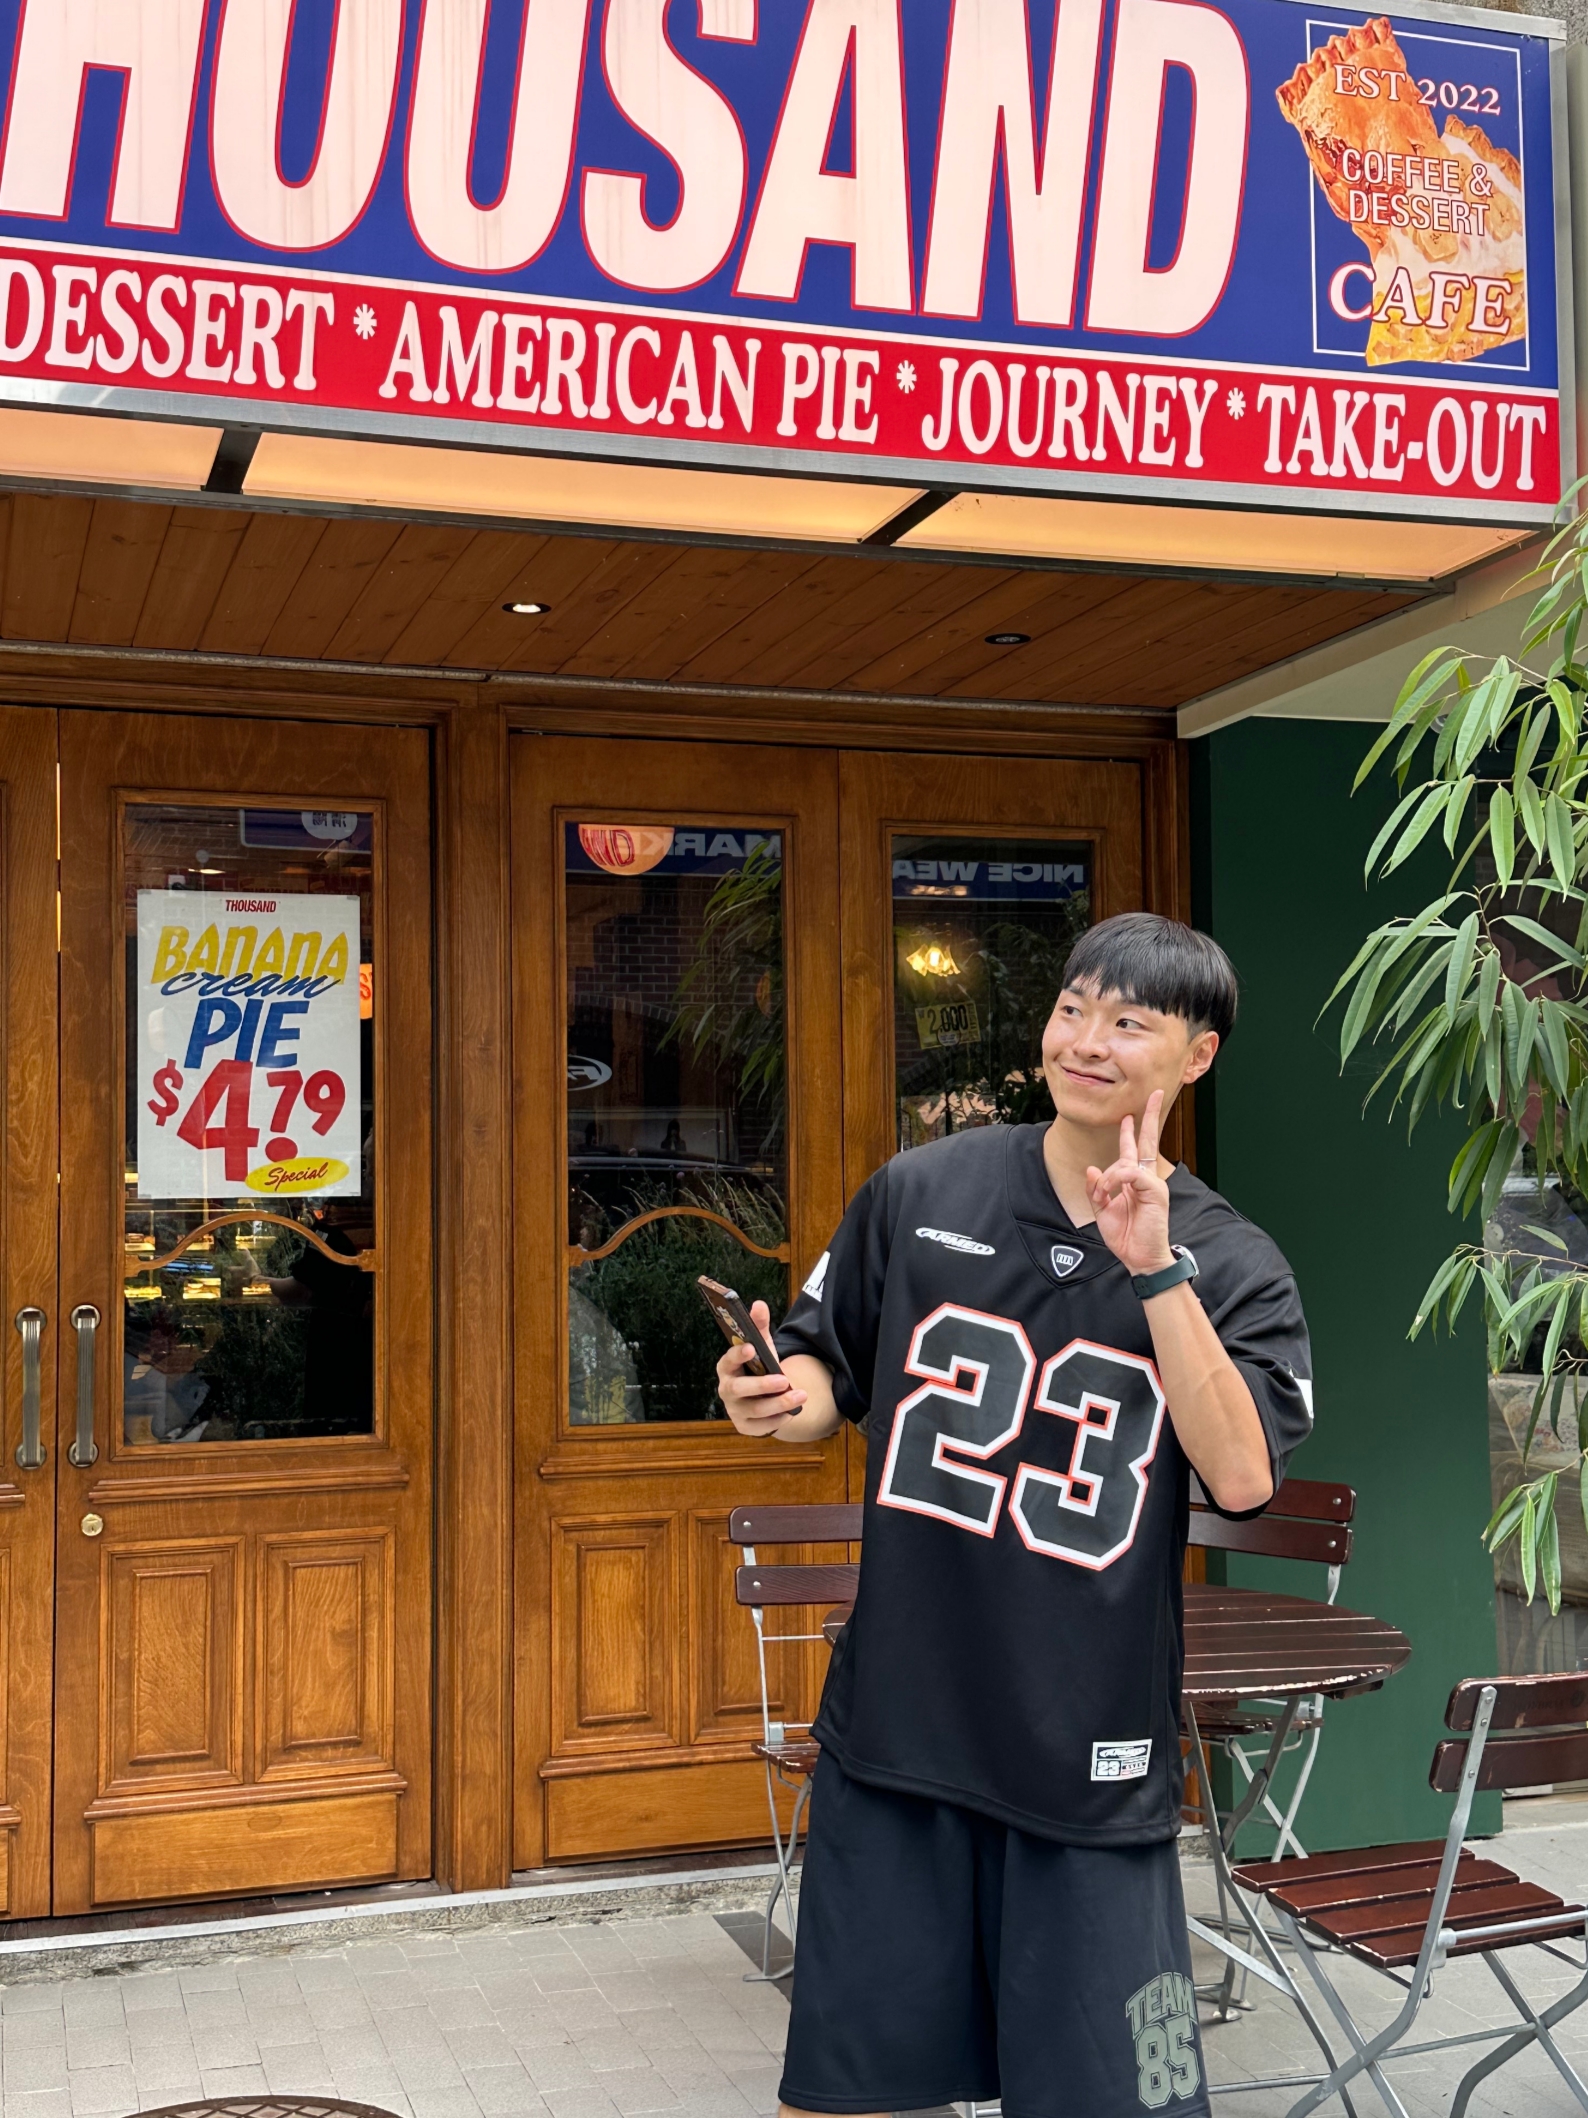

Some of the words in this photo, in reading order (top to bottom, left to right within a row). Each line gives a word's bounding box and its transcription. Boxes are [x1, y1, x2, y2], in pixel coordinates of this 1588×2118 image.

[1333, 63, 1406, 101] EST
[1417, 78, 1501, 115] 2022
[1342, 148, 1461, 194] COFFEE
[1470, 163, 1493, 197] &
[1348, 189, 1490, 236] DESSERT
[1328, 261, 1513, 336] CAFE
[0, 259, 335, 391] DESSERT
[379, 301, 762, 433] AMERICAN
[776, 340, 880, 445] PIE
[921, 358, 1219, 468] JOURNEY
[1257, 383, 1547, 491] TAKE-OUT
[225, 899, 277, 913] THOUSAND
[161, 971, 341, 999] cream
[184, 997, 310, 1069] PIE
[264, 1162, 329, 1192] Special
[876, 1302, 1168, 1572] 23
[1126, 1972, 1198, 2040] TEAM
[1135, 2013, 1200, 2109] 85
